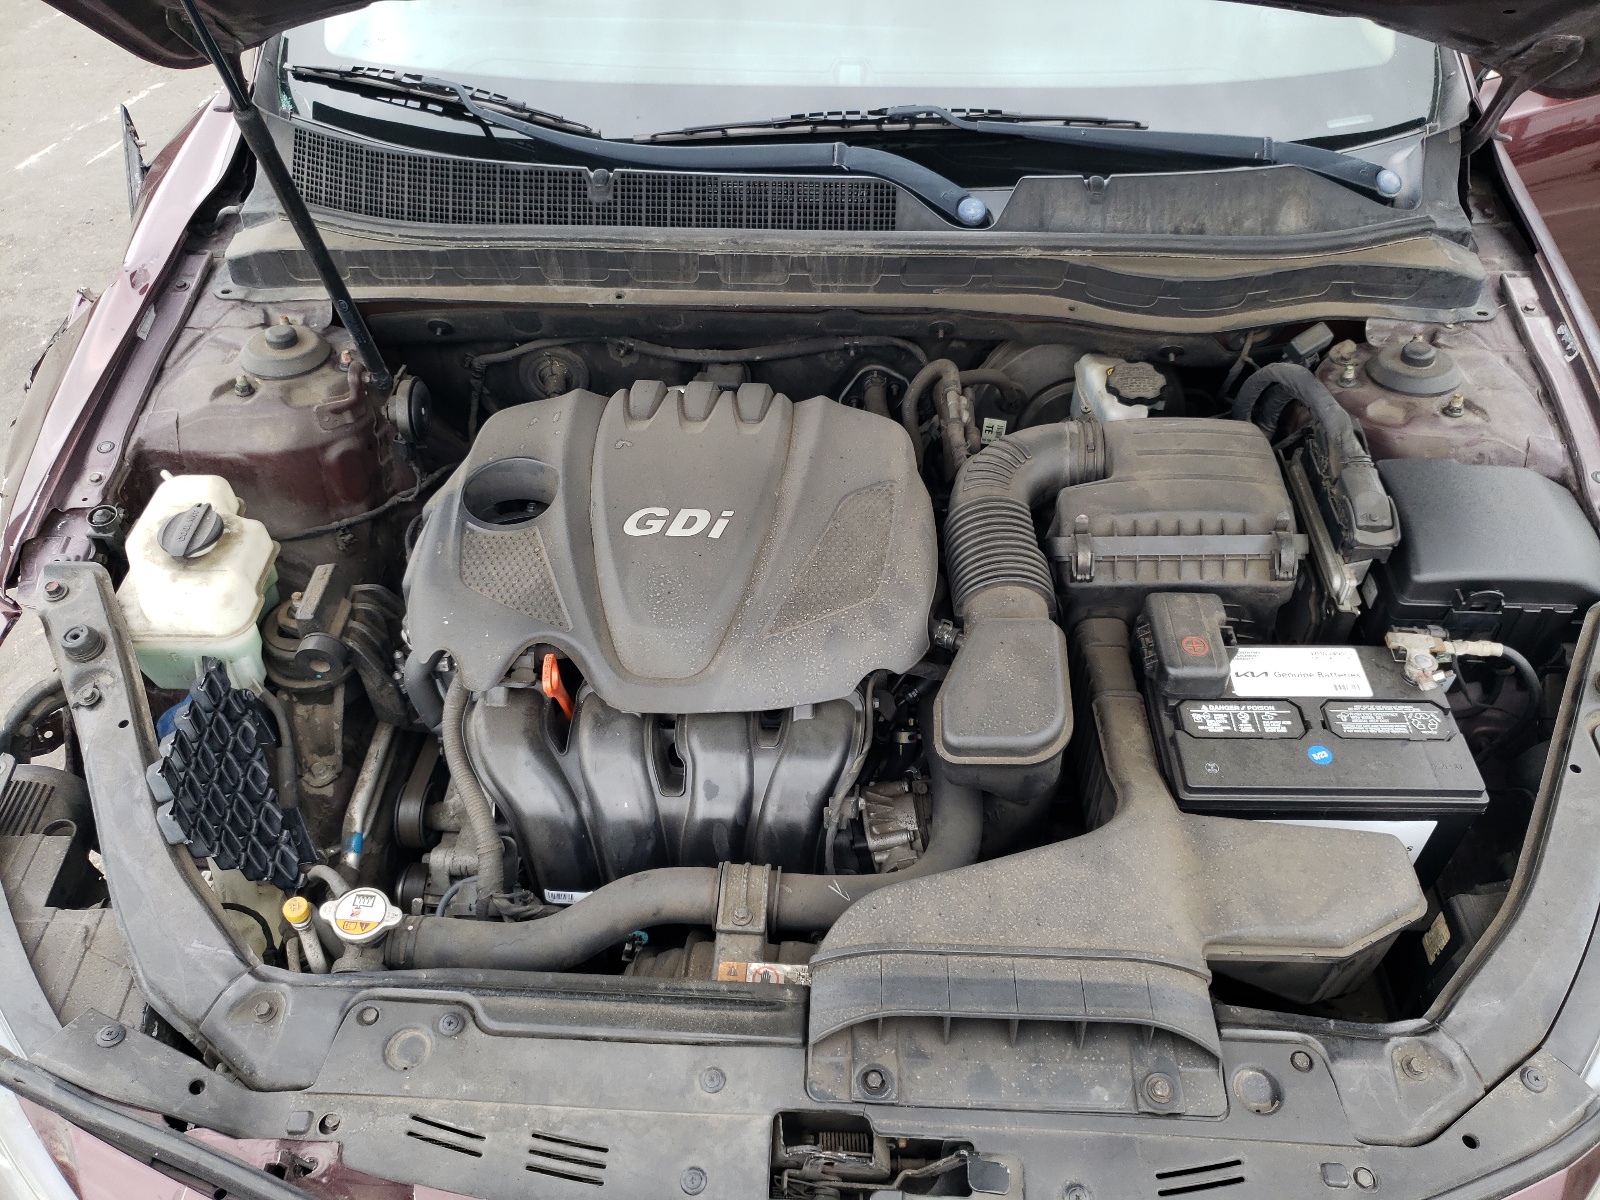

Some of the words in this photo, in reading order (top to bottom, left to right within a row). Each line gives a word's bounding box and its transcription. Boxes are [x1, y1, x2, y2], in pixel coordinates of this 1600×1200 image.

[623, 507, 735, 538] GDi
[1273, 671, 1314, 679] Genuine
[1317, 671, 1361, 679] Batteries
